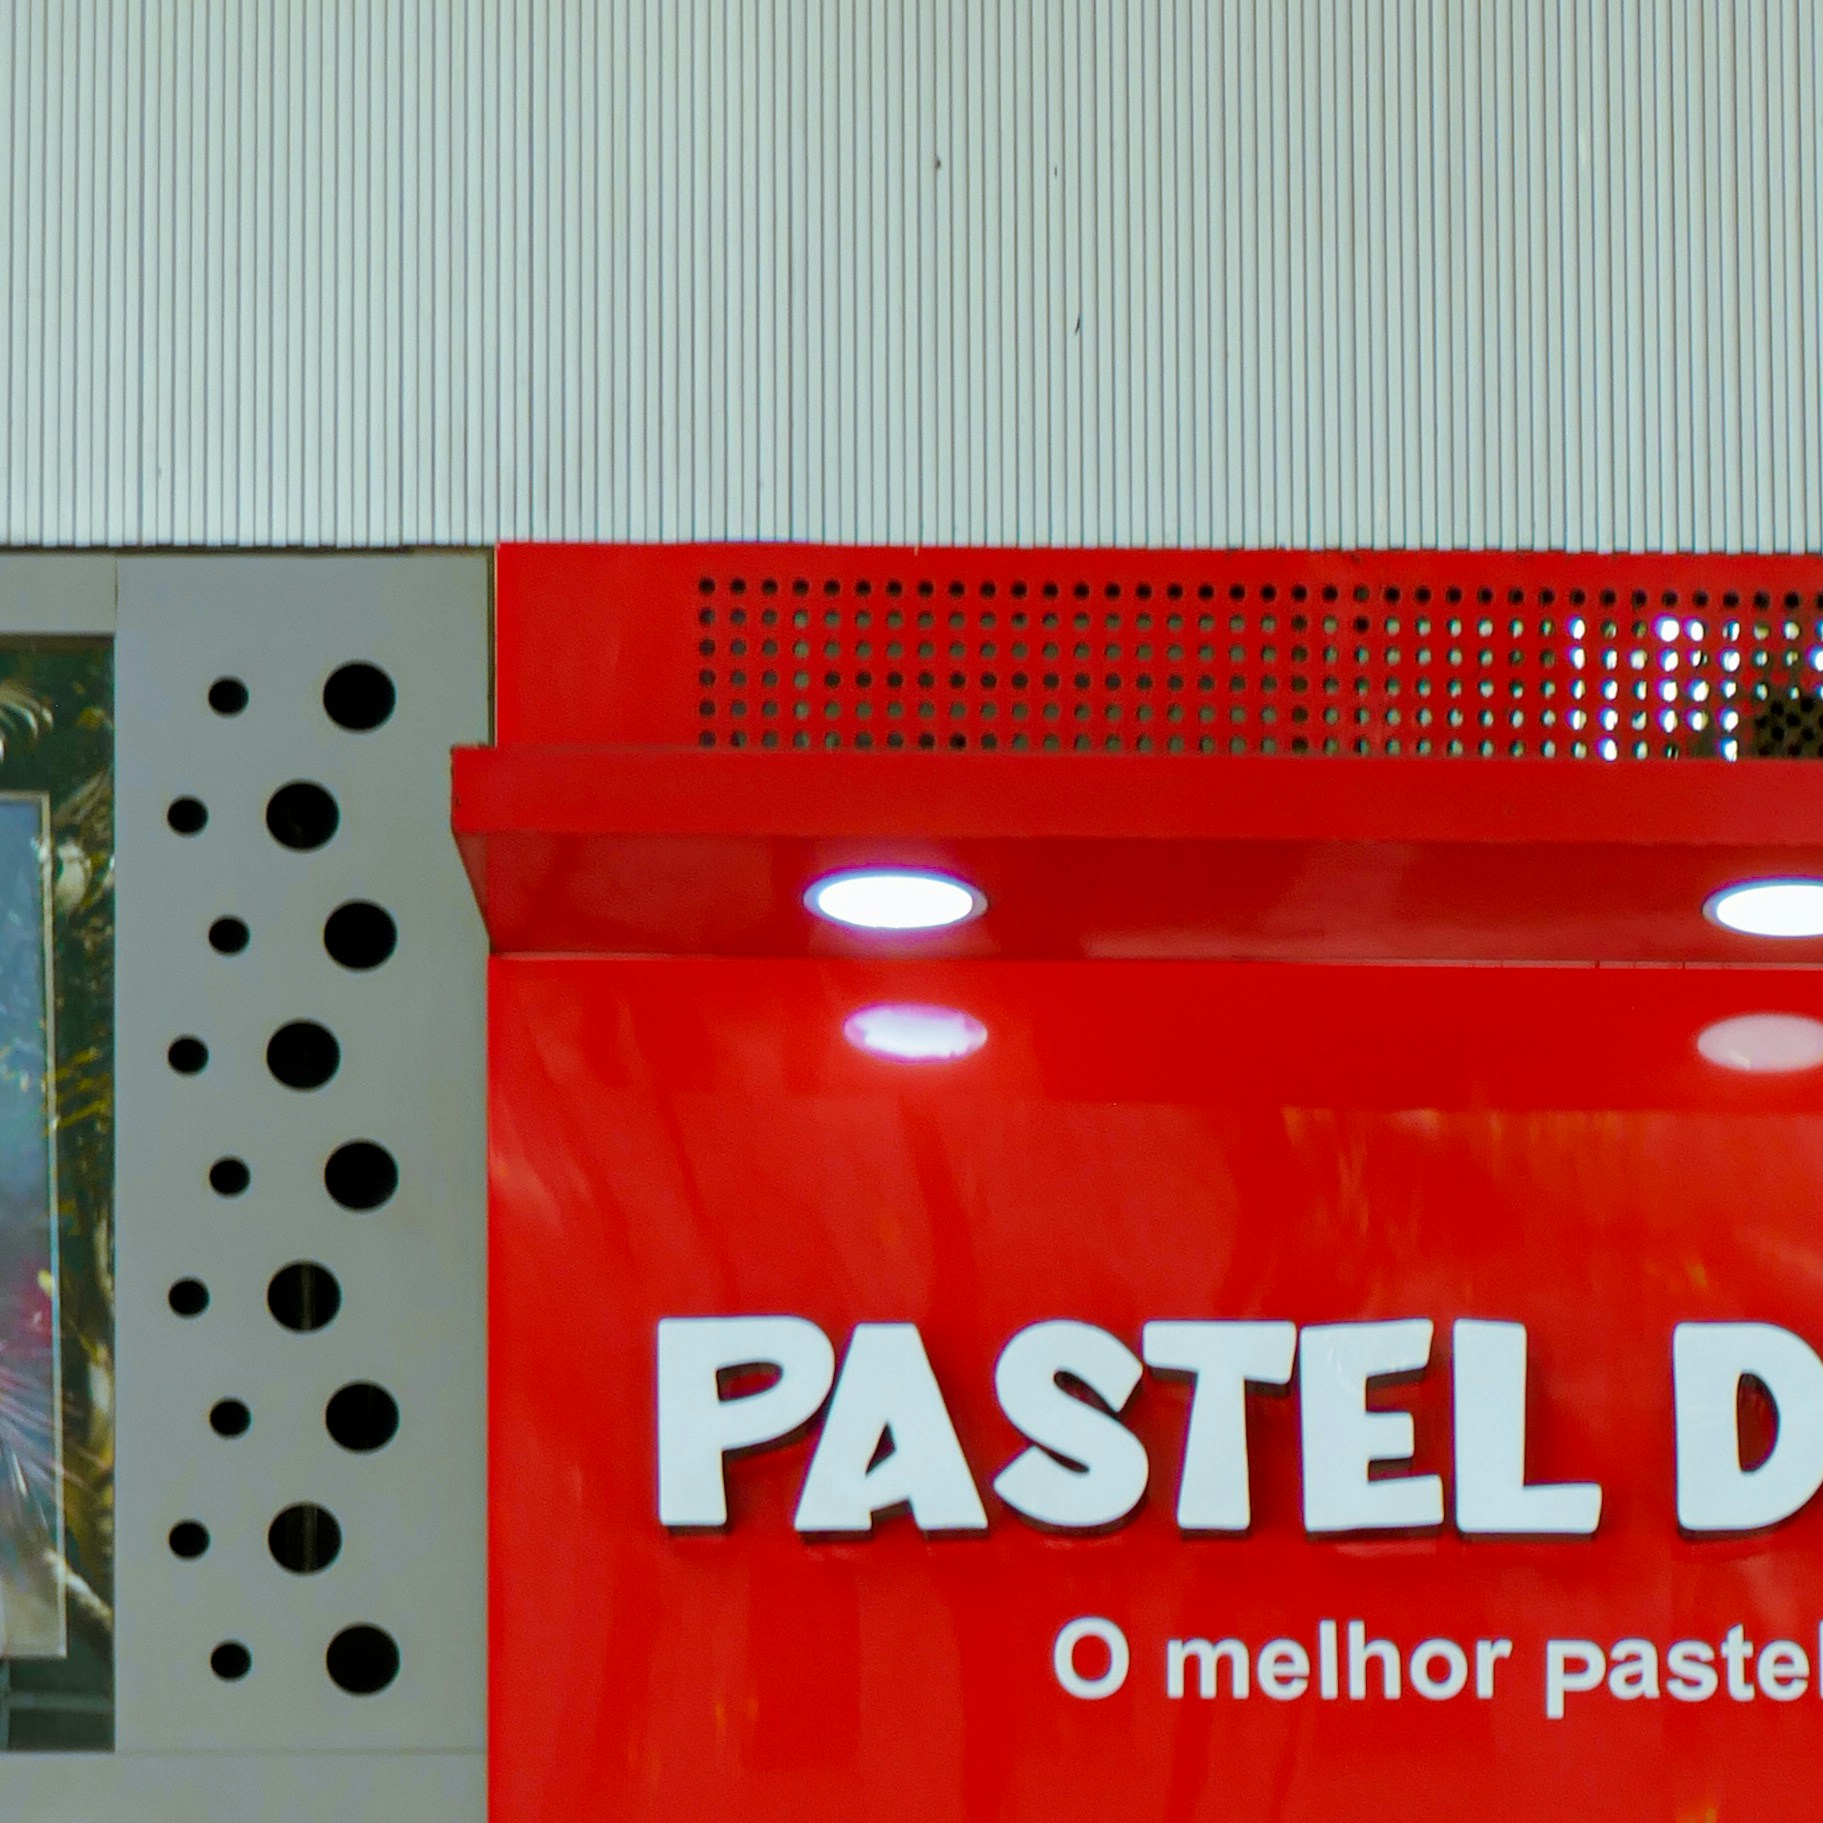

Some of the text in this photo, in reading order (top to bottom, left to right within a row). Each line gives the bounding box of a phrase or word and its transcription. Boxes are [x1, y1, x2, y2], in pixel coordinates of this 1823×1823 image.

[658, 1315, 1603, 1536] PASTEL
[1053, 1615, 1131, 1700] O
[1166, 1619, 1512, 1701] melhor
